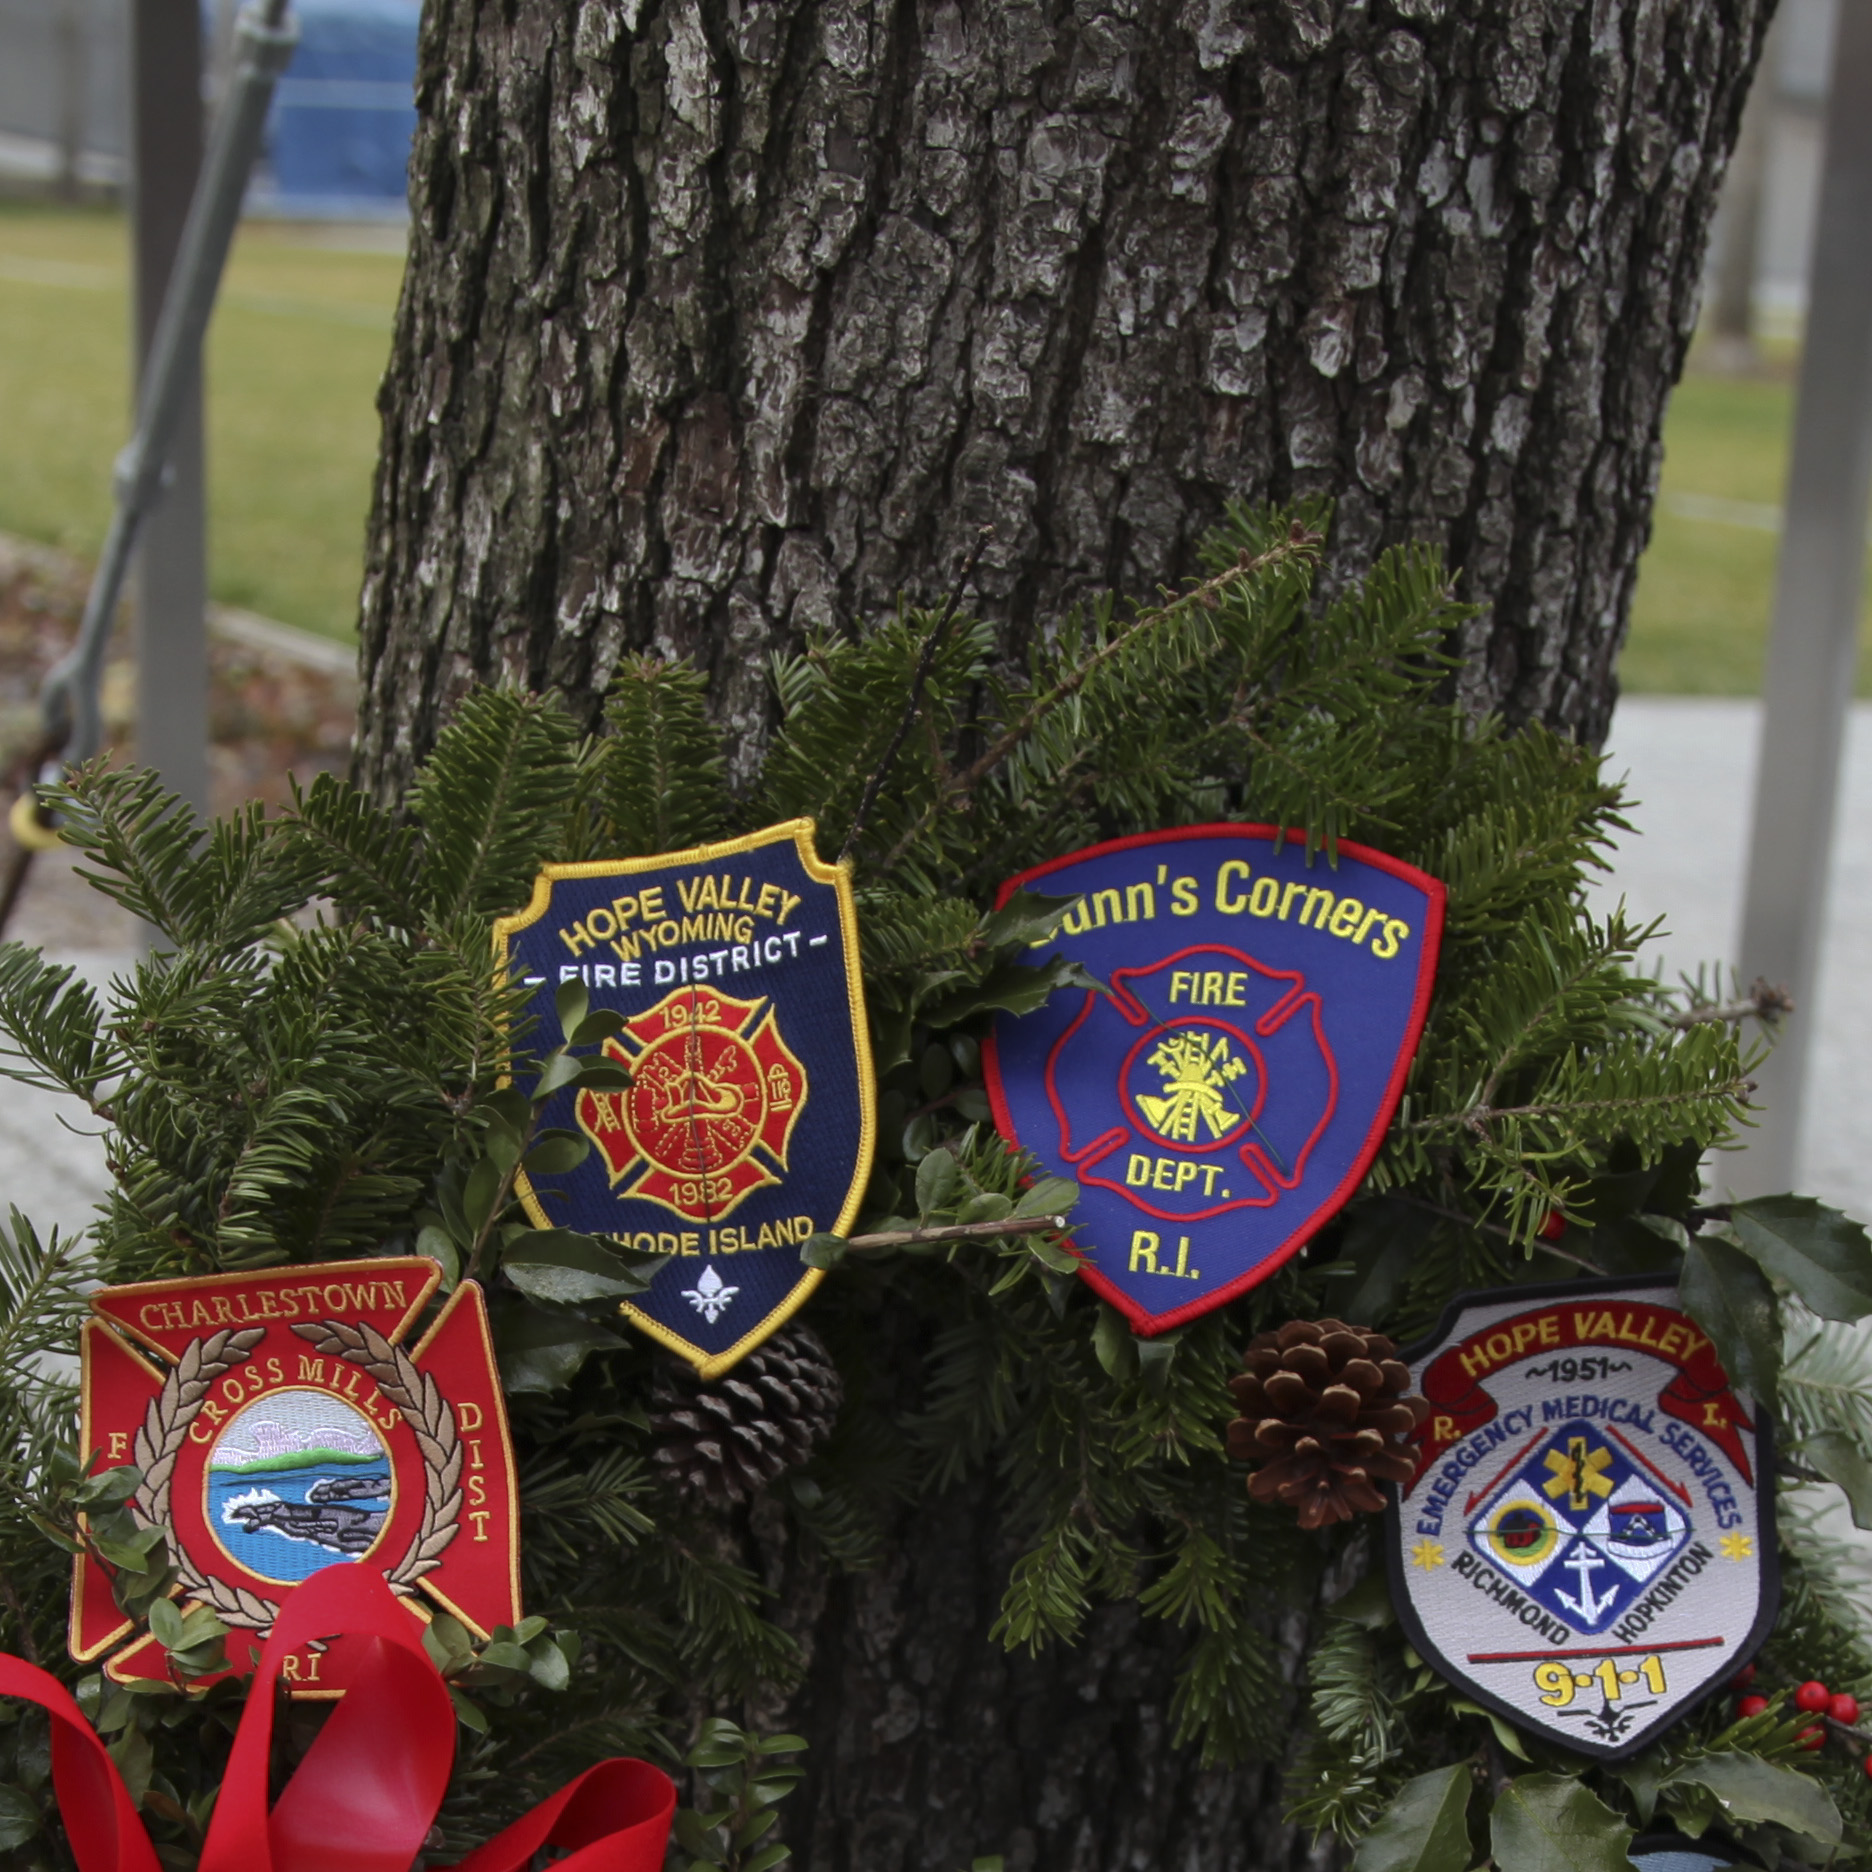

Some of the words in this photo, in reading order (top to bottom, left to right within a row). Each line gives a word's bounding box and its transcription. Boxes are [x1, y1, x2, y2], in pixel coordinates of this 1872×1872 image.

[559, 886, 667, 957] HOPE
[677, 874, 801, 925] VALLEY
[610, 912, 755, 962] WYOMING
[1030, 864, 1199, 949] unn's
[1215, 860, 1409, 960] Corners
[559, 962, 641, 988] FIRE
[655, 931, 801, 984] DISTRICT
[658, 1000, 722, 1027] 1942
[1169, 971, 1248, 1007] FIRE
[669, 1179, 733, 1206] 1982
[1126, 1154, 1231, 1198] DEPT.
[709, 1216, 814, 1254] ISLAND
[1129, 1230, 1200, 1280] R.I.
[139, 1281, 407, 1332] CHARLESTOWN
[1460, 1316, 1560, 1377] HOPE
[1574, 1311, 1707, 1361] VALLEY
[188, 1357, 284, 1445] CROSS
[297, 1354, 404, 1431] MILLS
[459, 1402, 490, 1542] DIST
[1416, 1405, 1533, 1537] EMERGENCY
[1542, 1394, 1655, 1434] MEDICAL
[1659, 1422, 1742, 1530] SERVICES
[1451, 1550, 1570, 1646] RICHMOND
[1612, 1541, 1714, 1645] HOPKINTON
